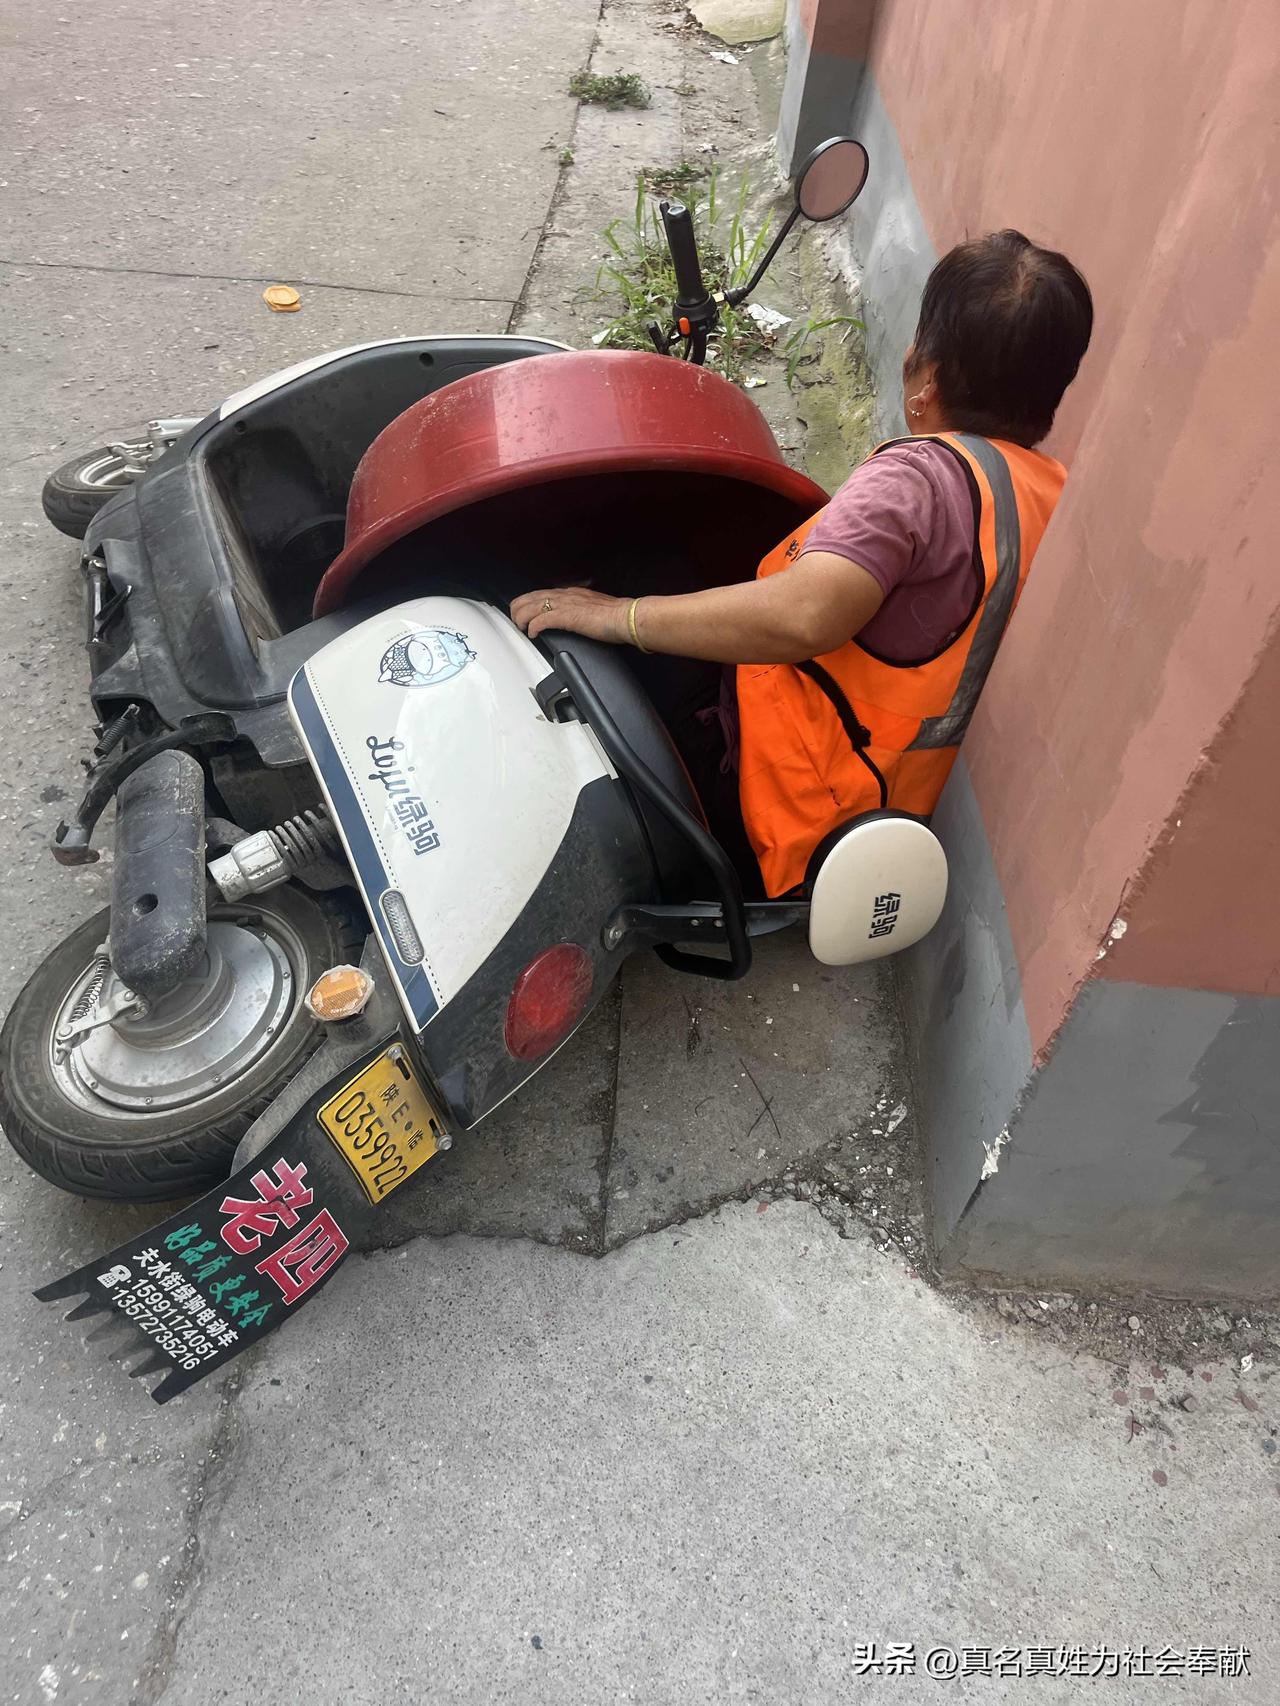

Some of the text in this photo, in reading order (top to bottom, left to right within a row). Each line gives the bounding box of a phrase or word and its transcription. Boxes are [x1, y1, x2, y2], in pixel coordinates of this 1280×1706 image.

[393, 796, 441, 856] 绿驹
[868, 892, 901, 939] 绿驹
[335, 1091, 408, 1196] 0359922
[219, 1156, 350, 1306] 老四
[110, 1288, 201, 1371] 13572735216
[133, 1277, 219, 1361] 15991174051
